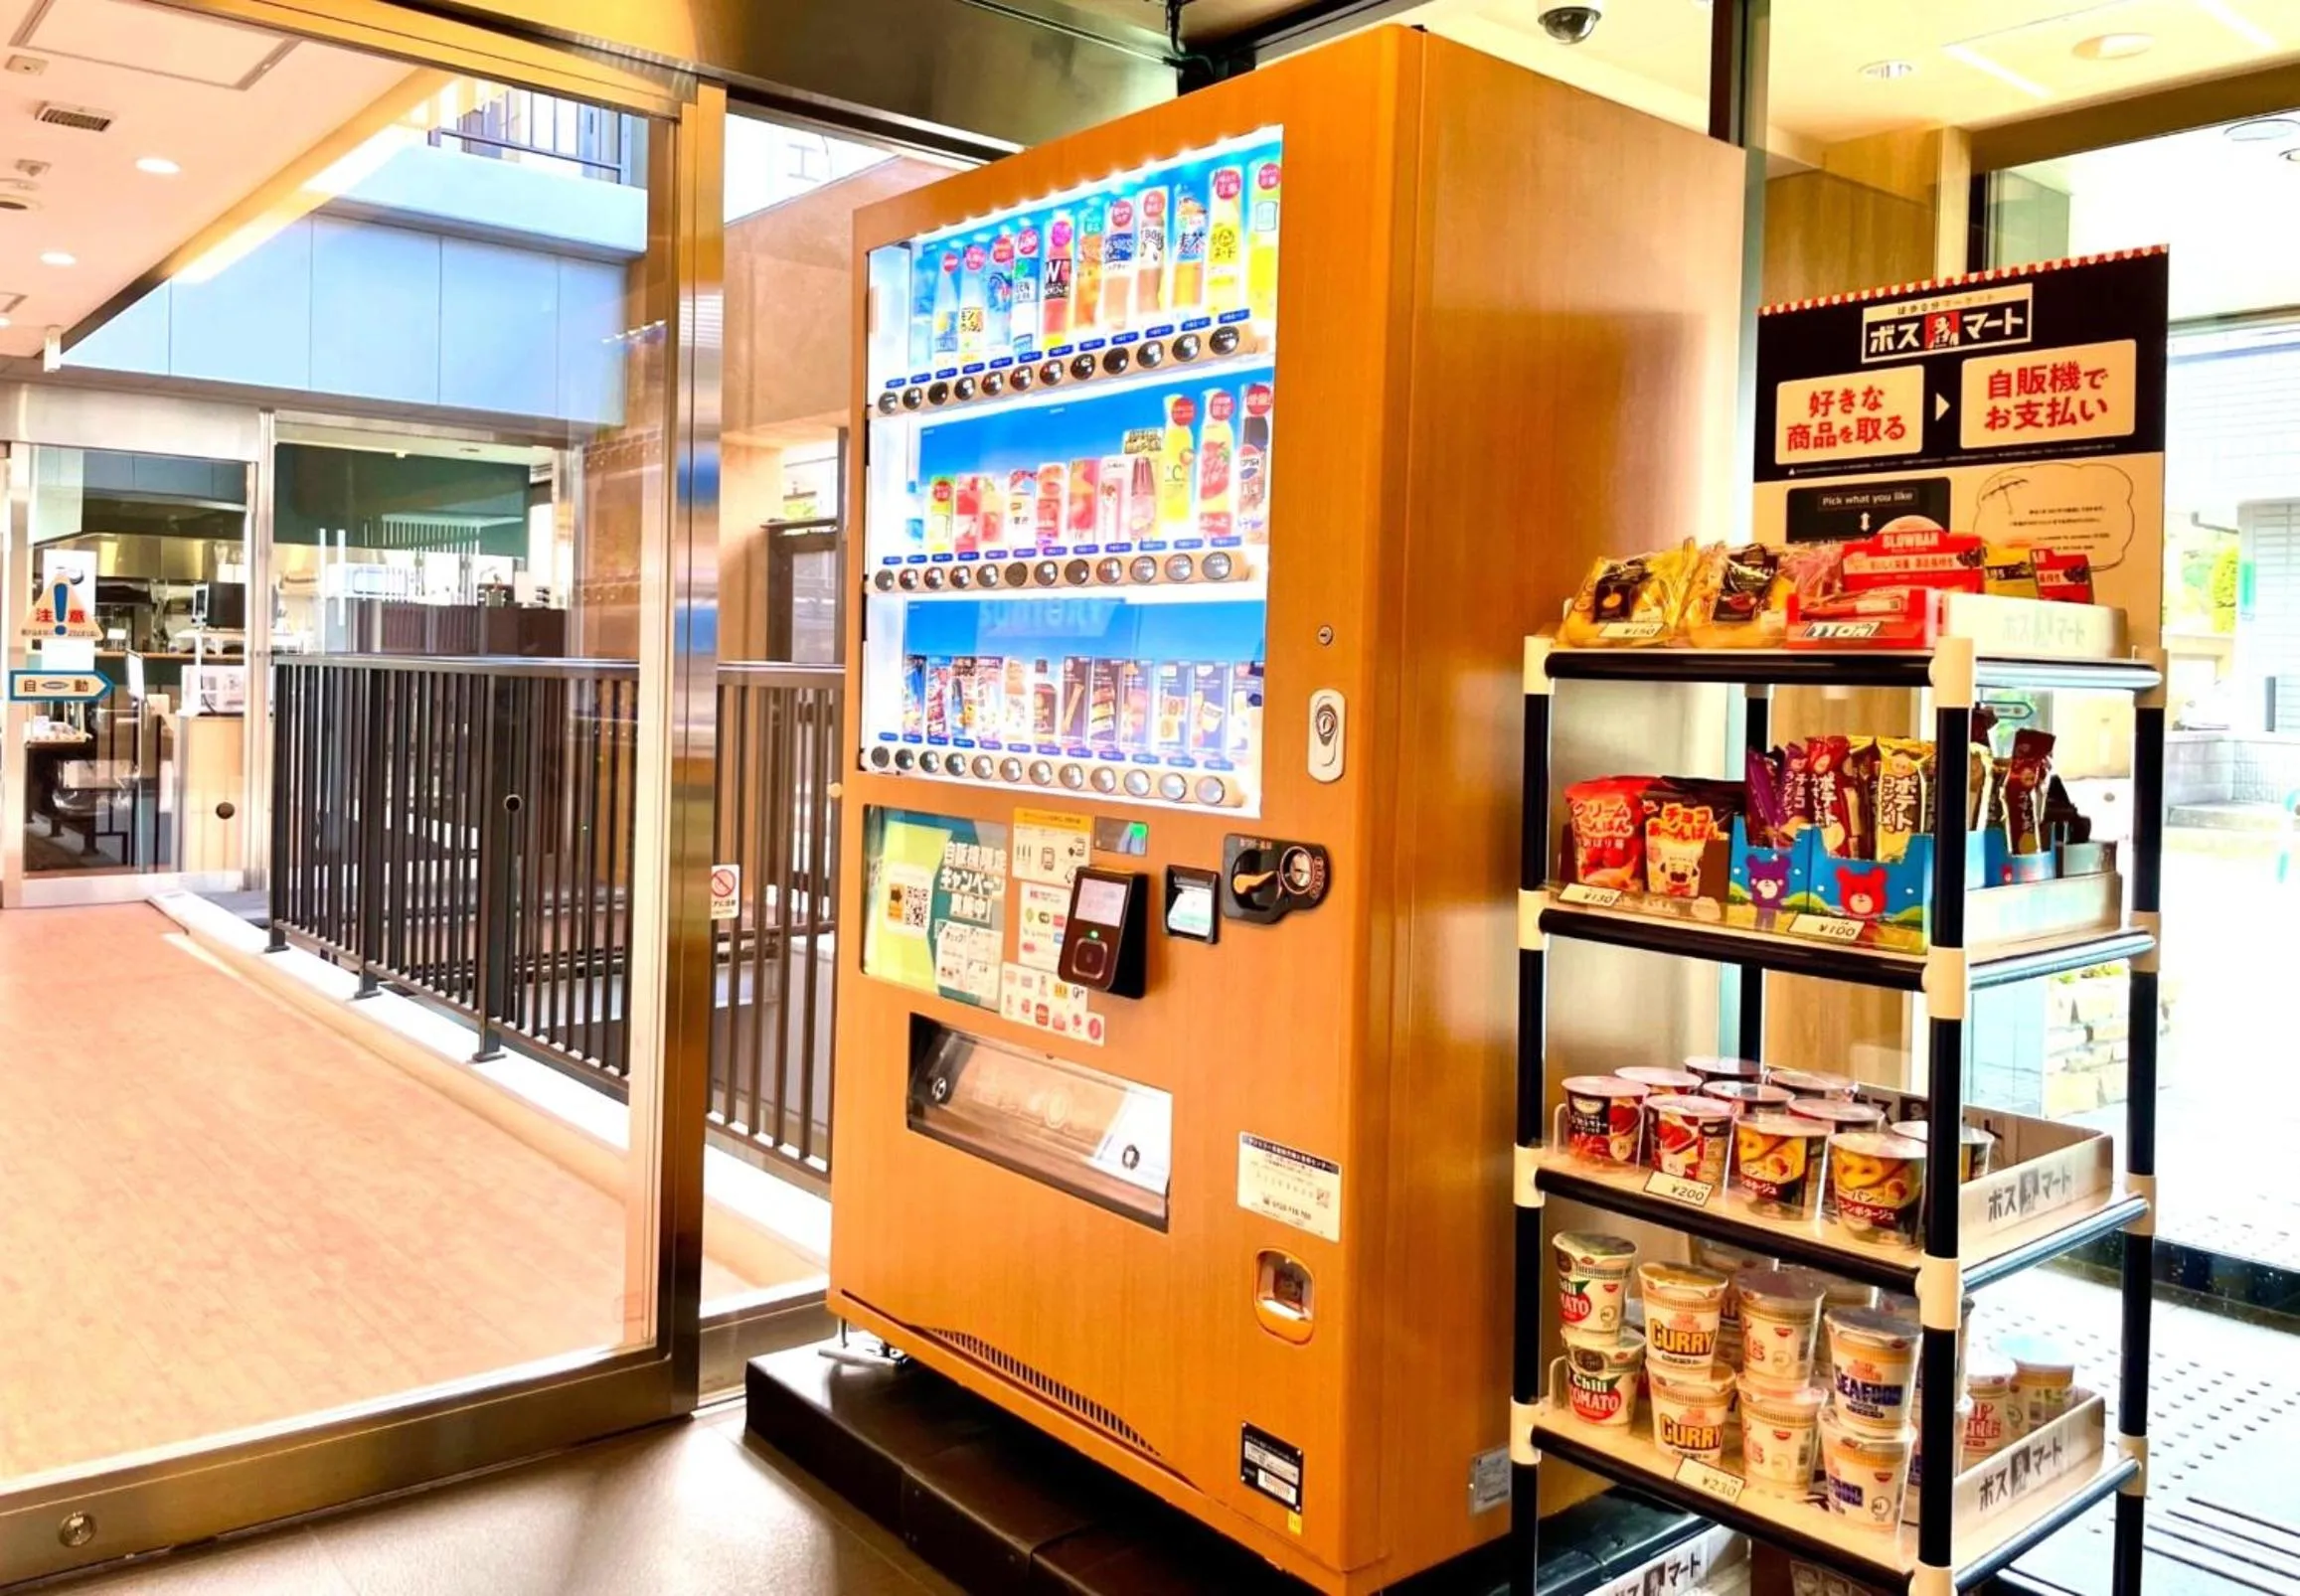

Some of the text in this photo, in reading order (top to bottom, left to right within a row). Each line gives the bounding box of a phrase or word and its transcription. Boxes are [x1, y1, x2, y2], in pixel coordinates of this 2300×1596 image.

[1870, 307, 2024, 354] ボス マート
[1988, 360, 2109, 400] 自販機で
[1808, 385, 1885, 418] 好きな
[1984, 396, 2108, 431] お支払い
[1786, 414, 1906, 451] 商品を取る
[1822, 491, 1913, 506] Pick what you like
[36, 607, 85, 623] 注意
[1820, 771, 1839, 827] ポテト
[1893, 775, 1918, 830] ポテト
[1664, 806, 1713, 828] チョコ
[1819, 922, 1856, 937] ¥100
[1671, 1183, 1705, 1201] ¥200
[1988, 1164, 2071, 1223] ボス マート
[1650, 1318, 1717, 1356] CURRY
[1572, 1372, 1607, 1392] Chili
[1702, 1475, 1737, 1498] ¥230
[1978, 1436, 2063, 1512] ボス マート
[1668, 1551, 1702, 1587] マート
